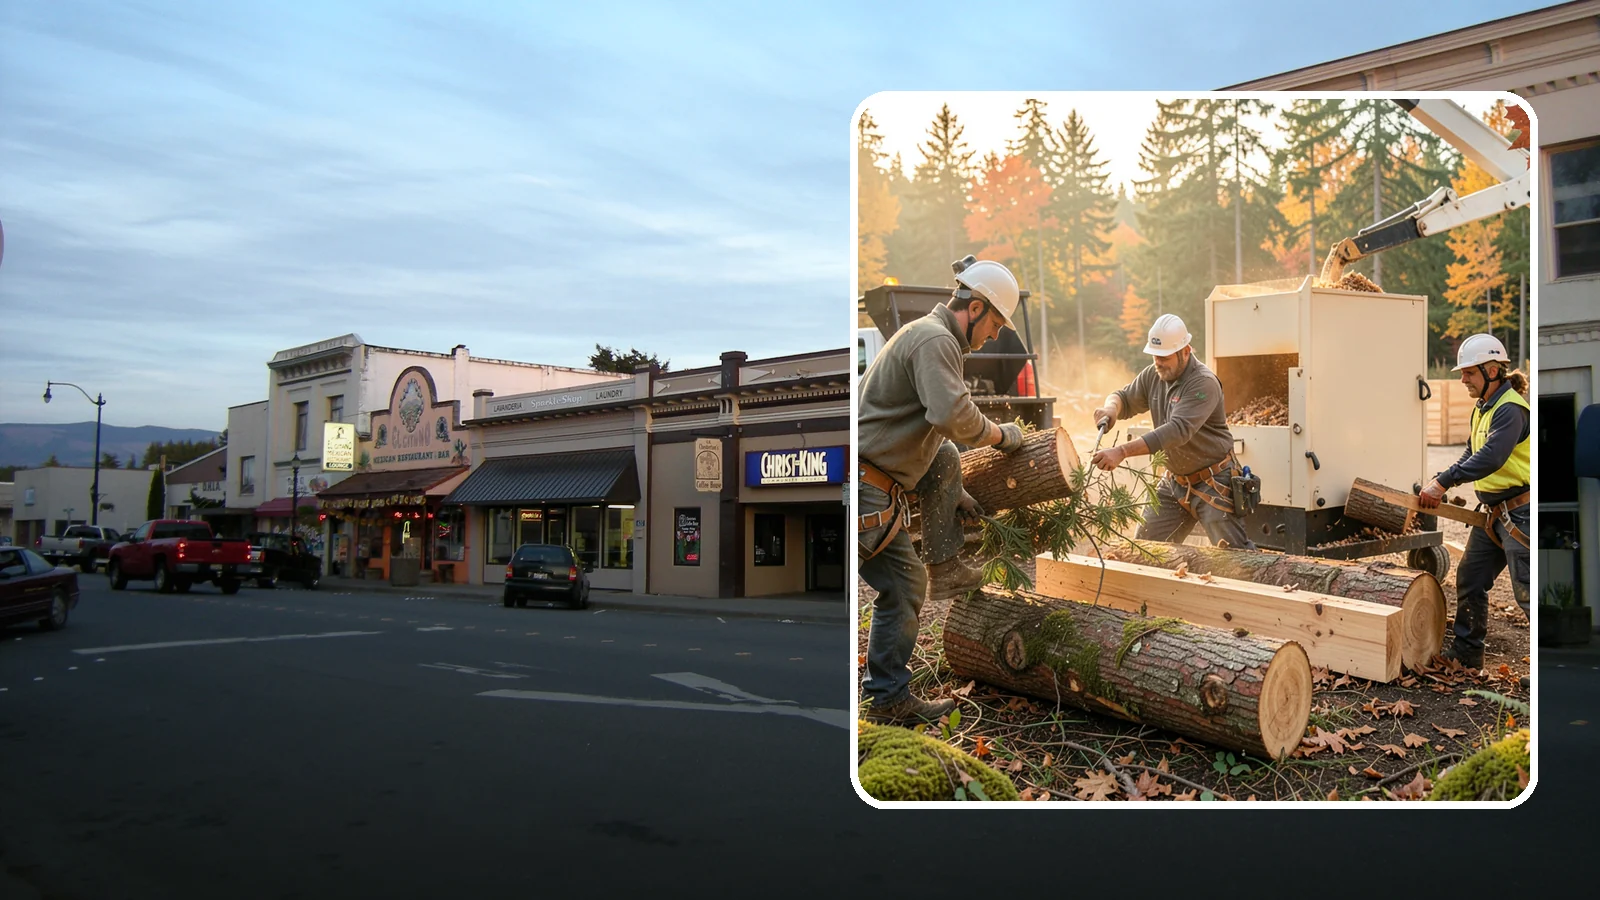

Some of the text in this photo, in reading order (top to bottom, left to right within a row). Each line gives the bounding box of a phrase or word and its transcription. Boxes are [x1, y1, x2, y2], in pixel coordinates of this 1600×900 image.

[595, 389, 623, 400] LAUNDRY
[493, 402, 523, 412] LAVANDERIA
[531, 395, 582, 409] Sparkle Shop
[392, 421, 431, 449] EL GITANO
[373, 455, 396, 464] MEXICAN
[397, 451, 434, 462] RESTAURANT
[438, 450, 450, 459] BAR
[696, 481, 722, 489] Coffee House
